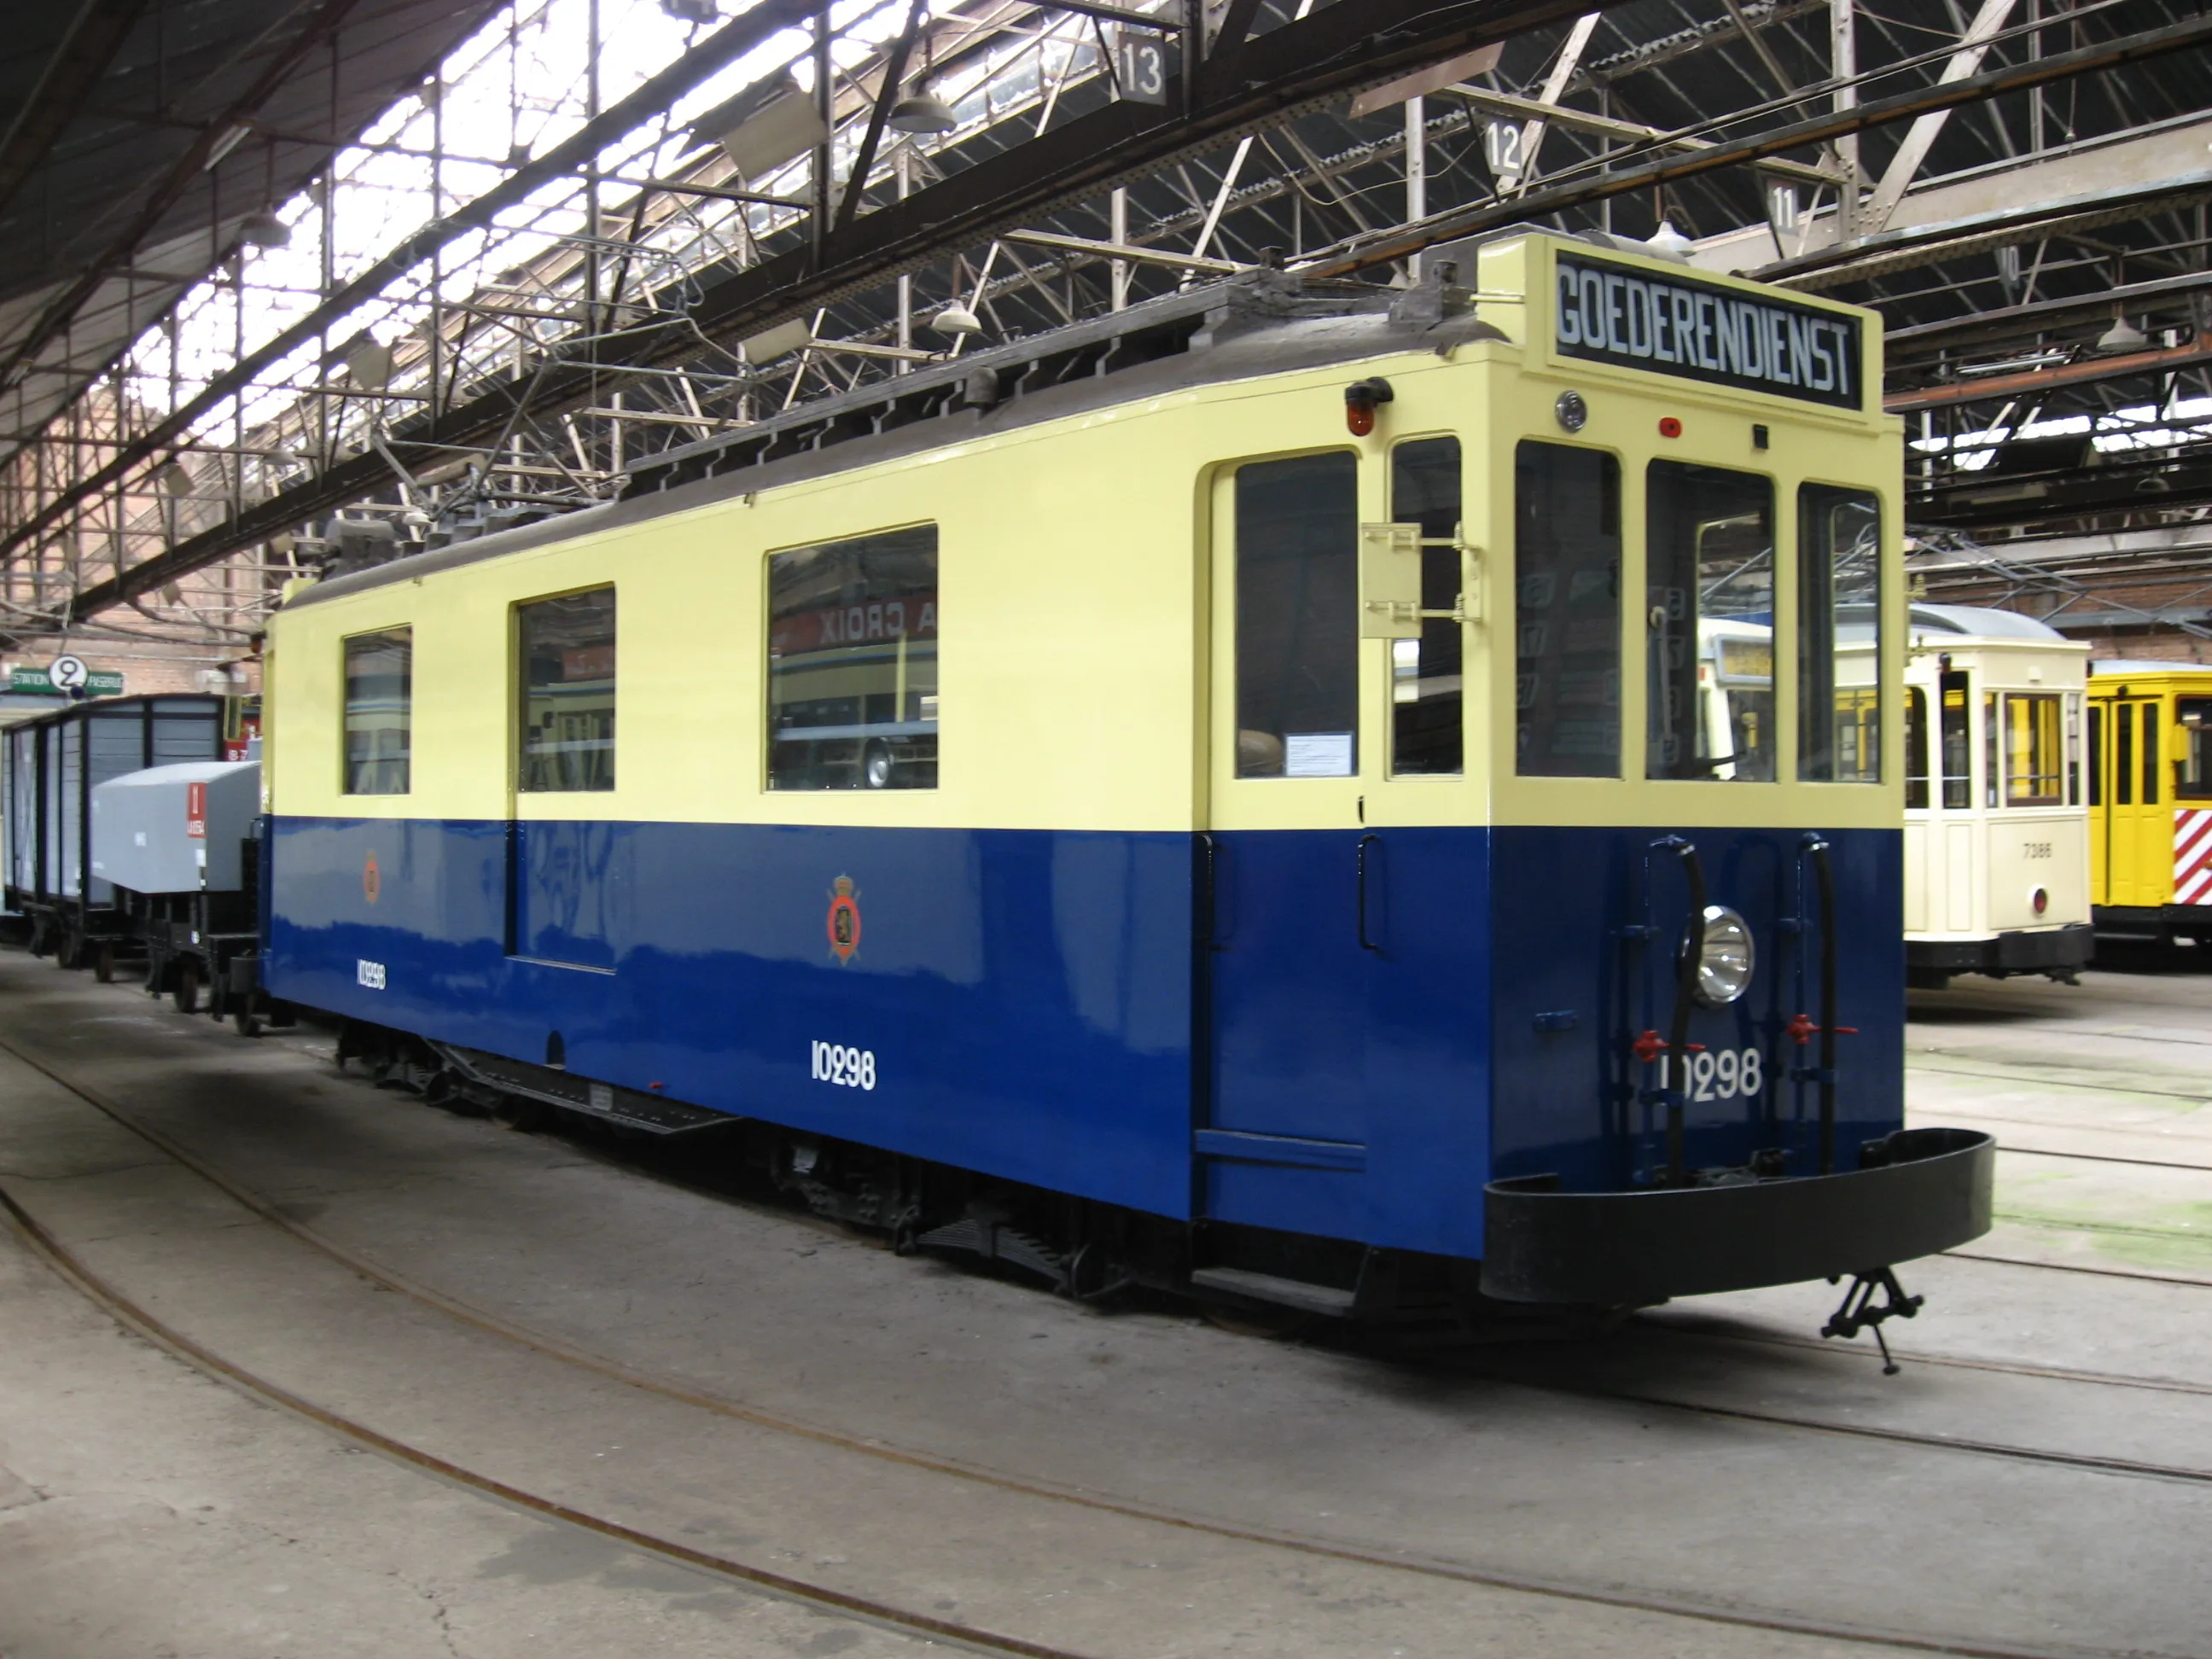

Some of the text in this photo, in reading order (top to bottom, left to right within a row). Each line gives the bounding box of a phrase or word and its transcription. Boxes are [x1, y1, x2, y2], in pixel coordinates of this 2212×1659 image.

[1123, 42, 1161, 95] 13
[1487, 122, 1520, 169] 12
[1773, 186, 1793, 229] 11
[1557, 263, 1849, 395] GOEDERENDIENST
[812, 1039, 876, 1091] 10298
